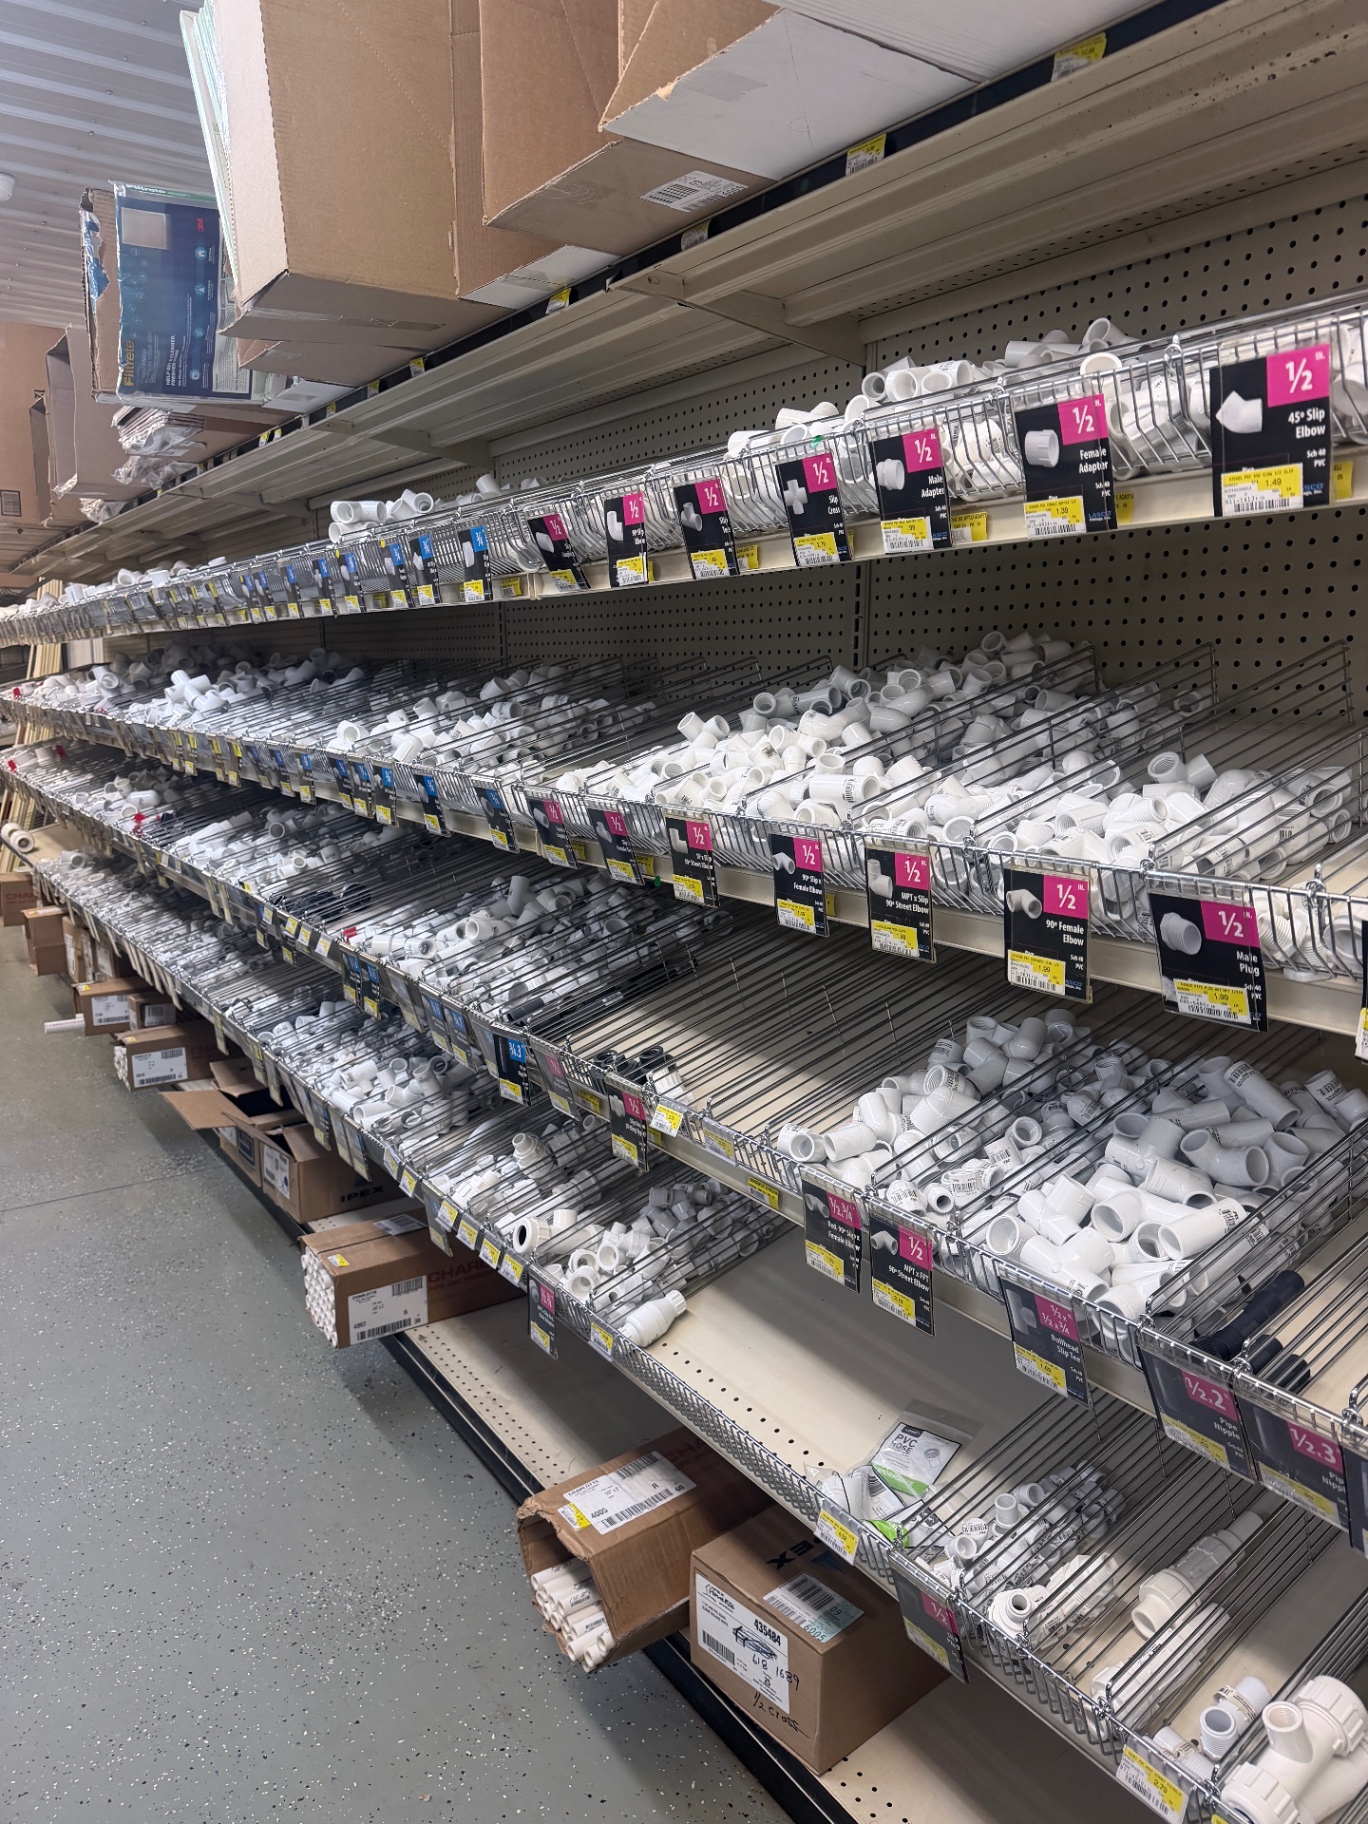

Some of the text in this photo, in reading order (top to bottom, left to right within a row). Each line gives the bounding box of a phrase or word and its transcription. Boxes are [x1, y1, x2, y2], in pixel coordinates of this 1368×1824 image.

[123, 340, 135, 387] Filtrete
[1285, 358, 1313, 393] 1/2
[1072, 405, 1095, 434] 1/2
[1306, 407, 1326, 424] Slip
[1296, 423, 1326, 439] Elbow
[1080, 447, 1107, 461] Female
[1307, 449, 1317, 458] Sch
[1079, 460, 1109, 474] Adapter
[1314, 459, 1326, 467] PVC
[928, 474, 943, 485] Male
[1266, 478, 1281, 487] 1.49
[904, 860, 920, 883] 1/2
[1057, 884, 1076, 910] 1/2
[895, 902, 912, 911] Street
[913, 904, 929, 914] Elbow
[1059, 921, 1084, 935] Female
[1218, 910, 1244, 938] 1/2
[1063, 934, 1084, 947] Elbow
[1236, 951, 1258, 963] Male
[1239, 963, 1260, 976] Plug
[1065, 979, 1083, 987] ASCO
[340, 1185, 385, 1203] IPEX
[908, 1236, 923, 1261] 1/2
[1051, 1333, 1079, 1354] Bullhead
[1056, 1345, 1080, 1363] Slip Tee
[1213, 1421, 1241, 1440] Nipple
[1219, 1416, 1238, 1431] Pipe
[894, 1434, 918, 1448] PVC
[1321, 1475, 1346, 1493] Nippl
[1328, 1471, 1344, 1484] Pip
[803, 1623, 828, 1642] 6005
[775, 1666, 800, 1691] 1689
[1153, 1779, 1168, 1794] 2.79
